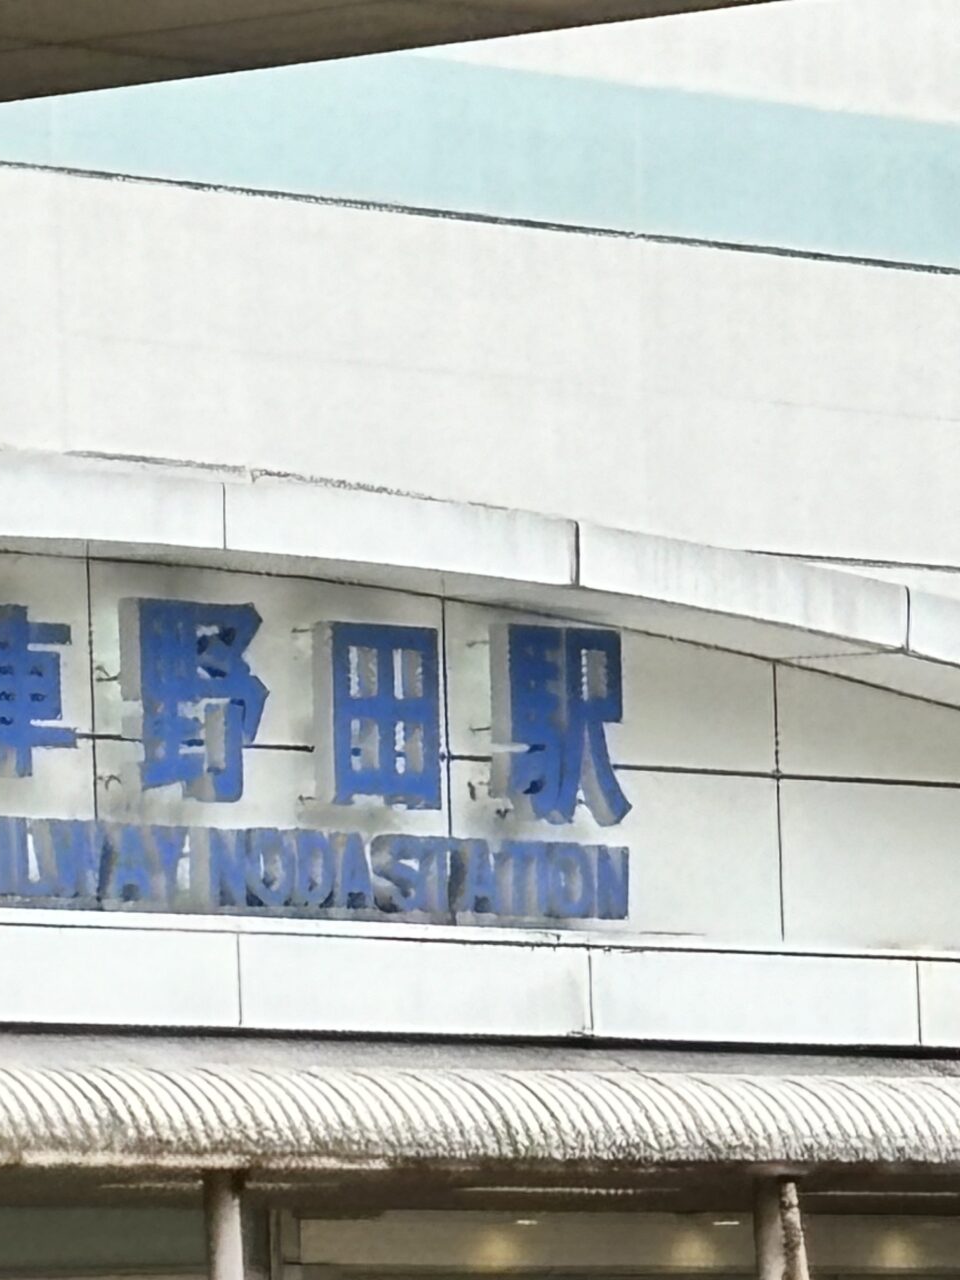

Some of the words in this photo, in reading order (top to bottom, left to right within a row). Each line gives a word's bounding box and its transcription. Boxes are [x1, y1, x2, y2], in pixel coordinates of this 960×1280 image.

[125, 598, 633, 826] 野田駅
[206, 827, 376, 910] NODA
[372, 834, 630, 921] STATION
